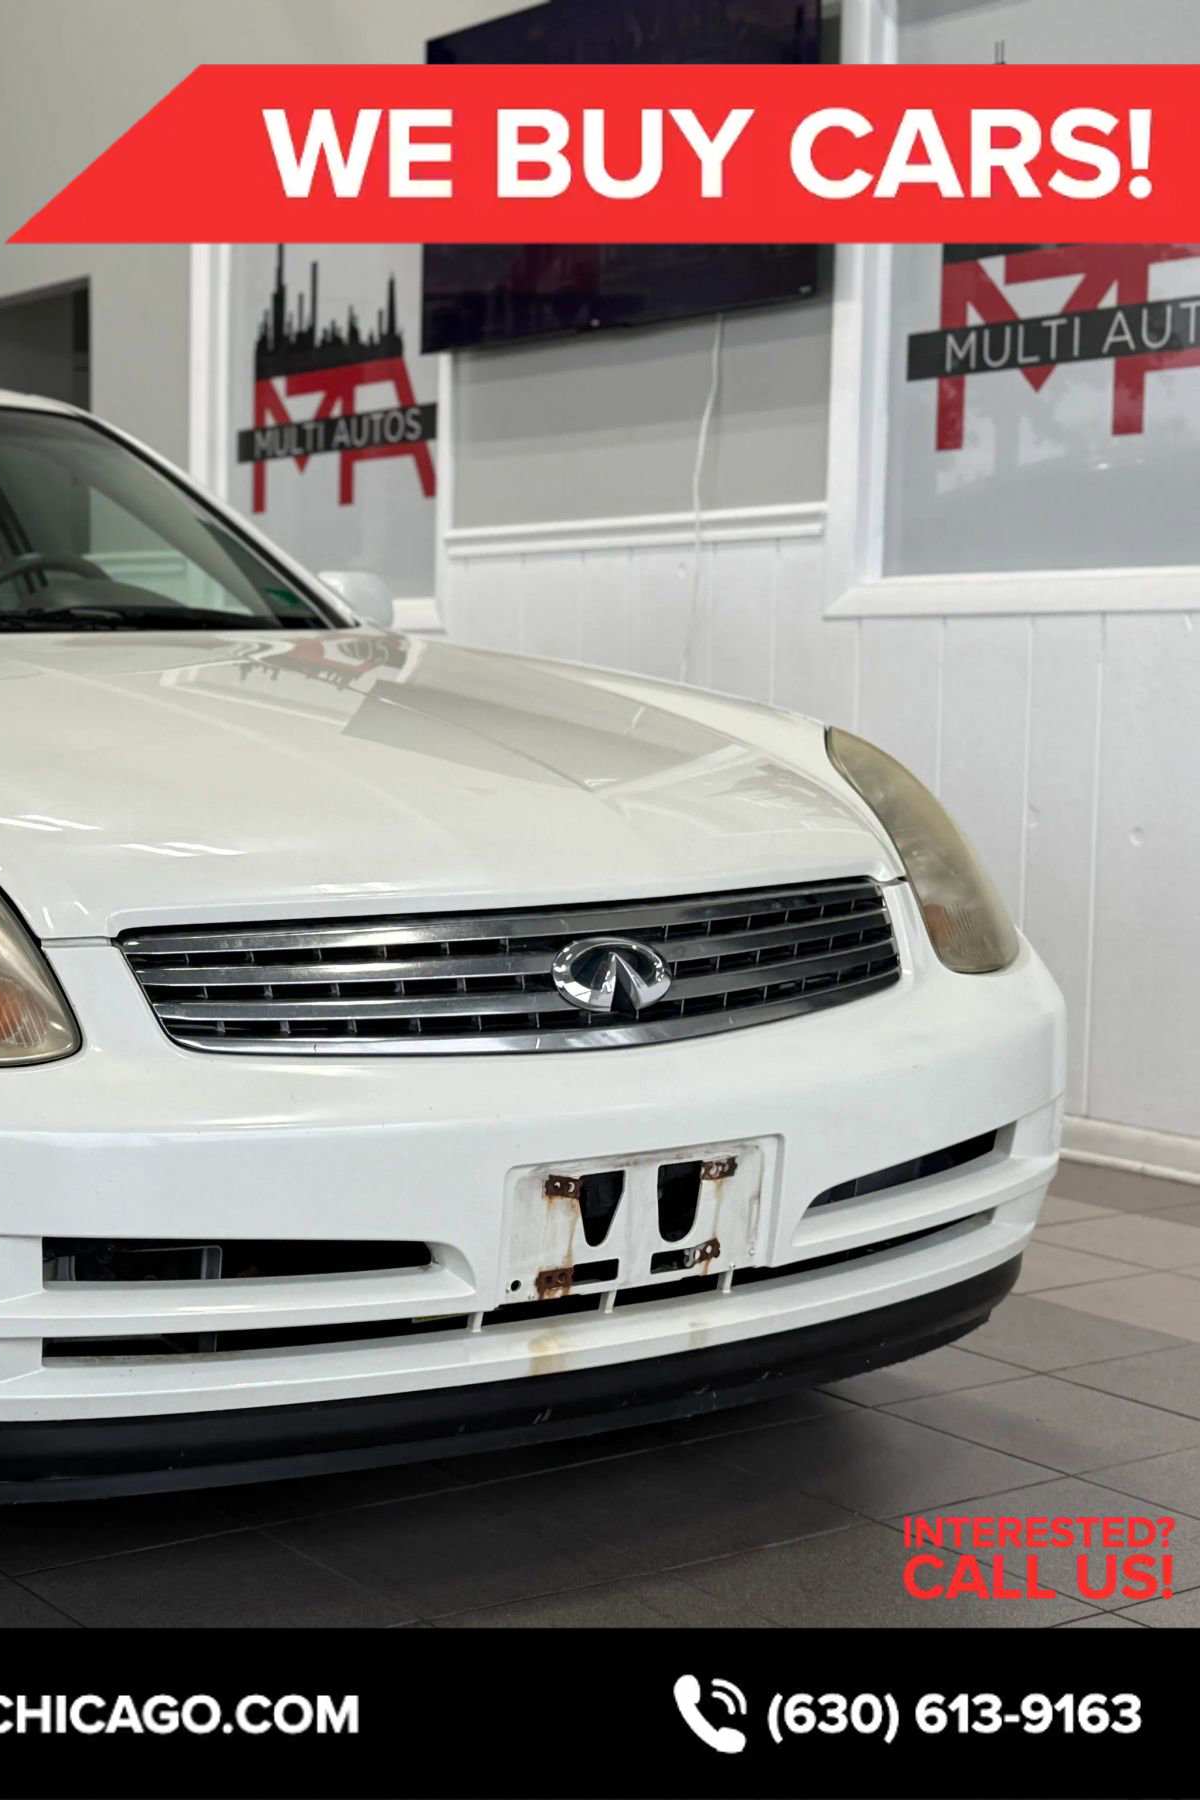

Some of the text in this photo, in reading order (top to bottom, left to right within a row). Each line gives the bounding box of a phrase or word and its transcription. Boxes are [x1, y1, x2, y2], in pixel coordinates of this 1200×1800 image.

[944, 315, 1080, 374] MULTI
[253, 407, 423, 458] MULTI AUTOS
